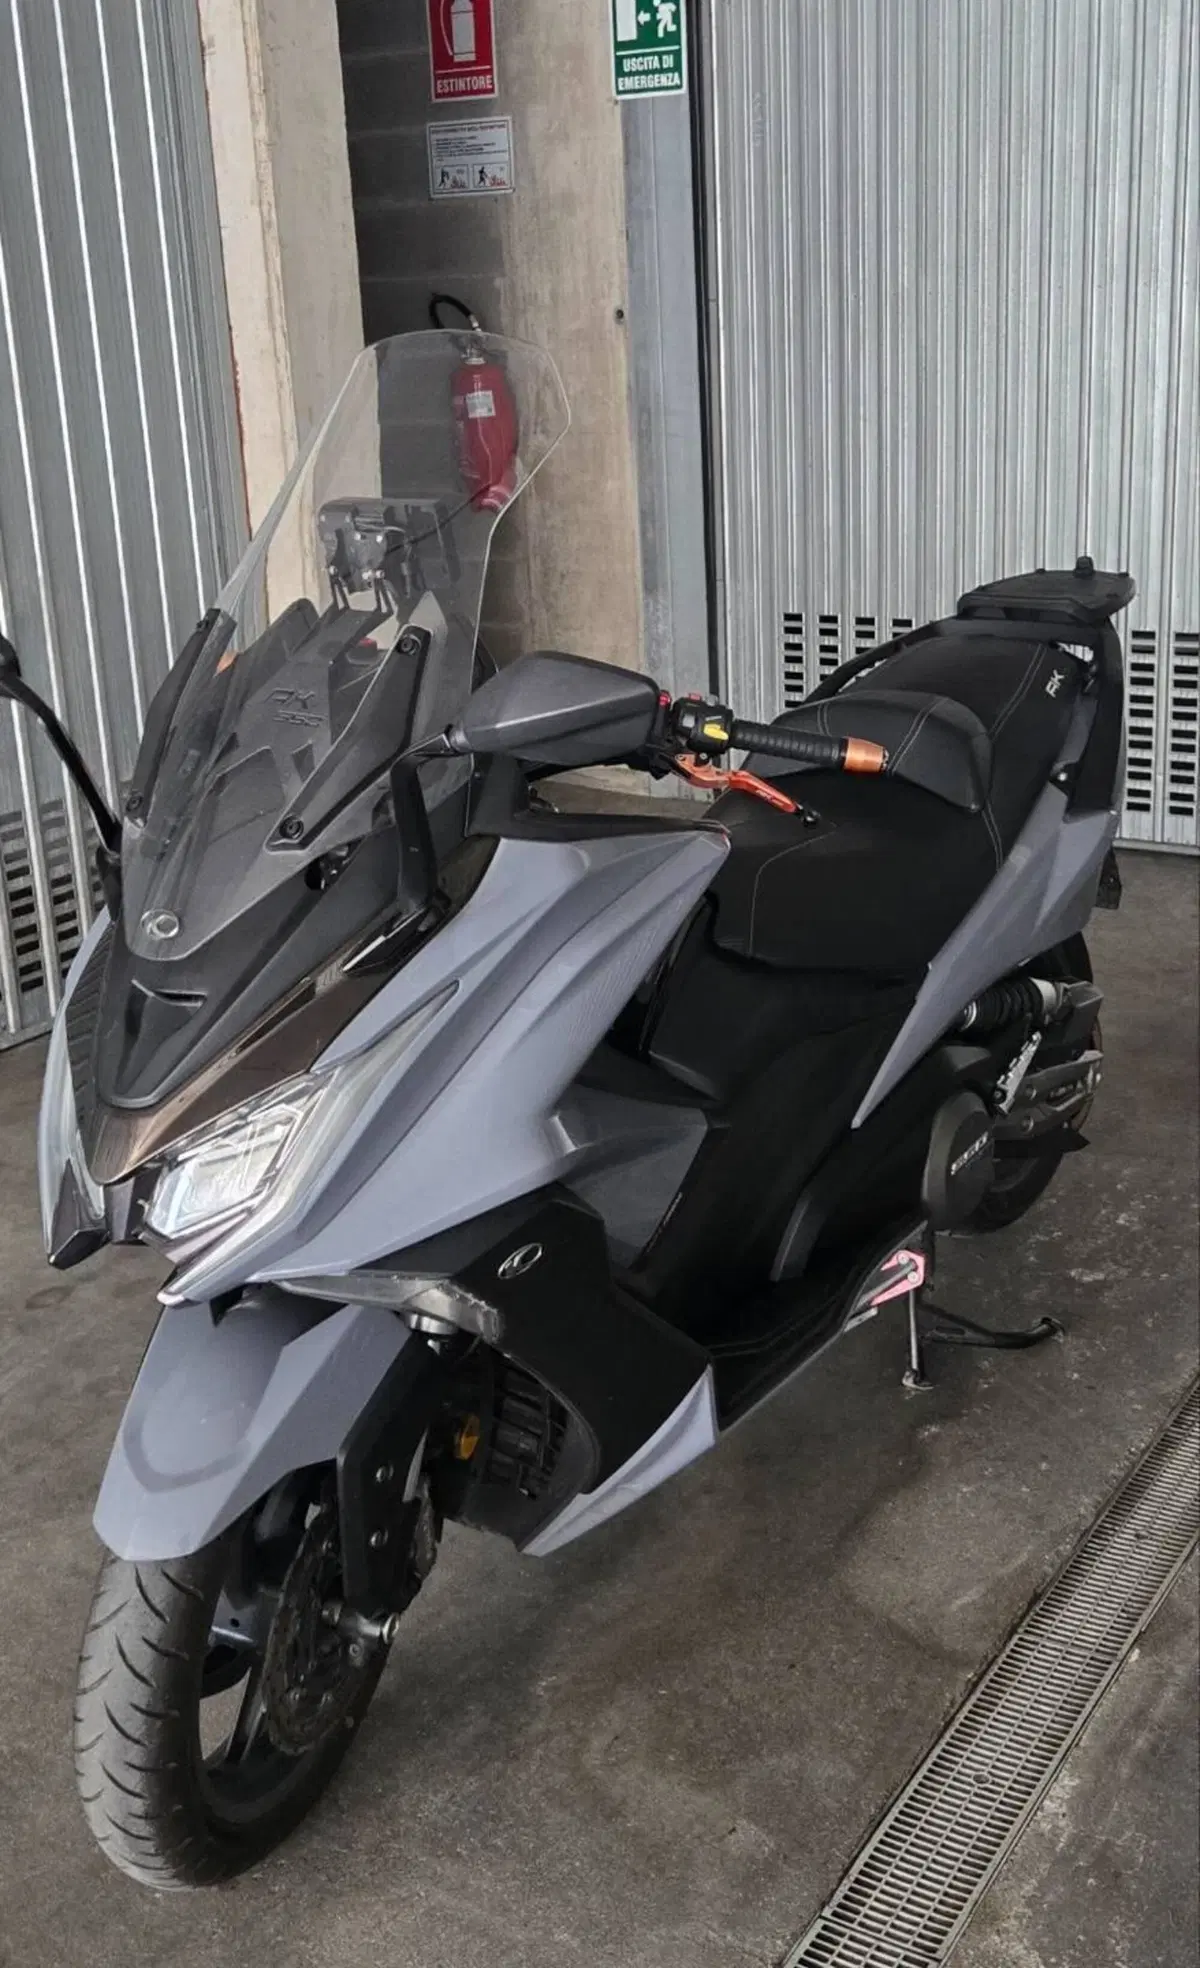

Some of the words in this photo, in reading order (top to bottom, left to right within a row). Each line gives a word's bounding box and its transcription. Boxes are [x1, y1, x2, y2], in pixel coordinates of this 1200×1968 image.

[622, 55, 660, 72] USCITA
[662, 54, 674, 69] DI
[436, 75, 493, 93] ESTINTORE
[617, 72, 681, 91] EMERGENZA
